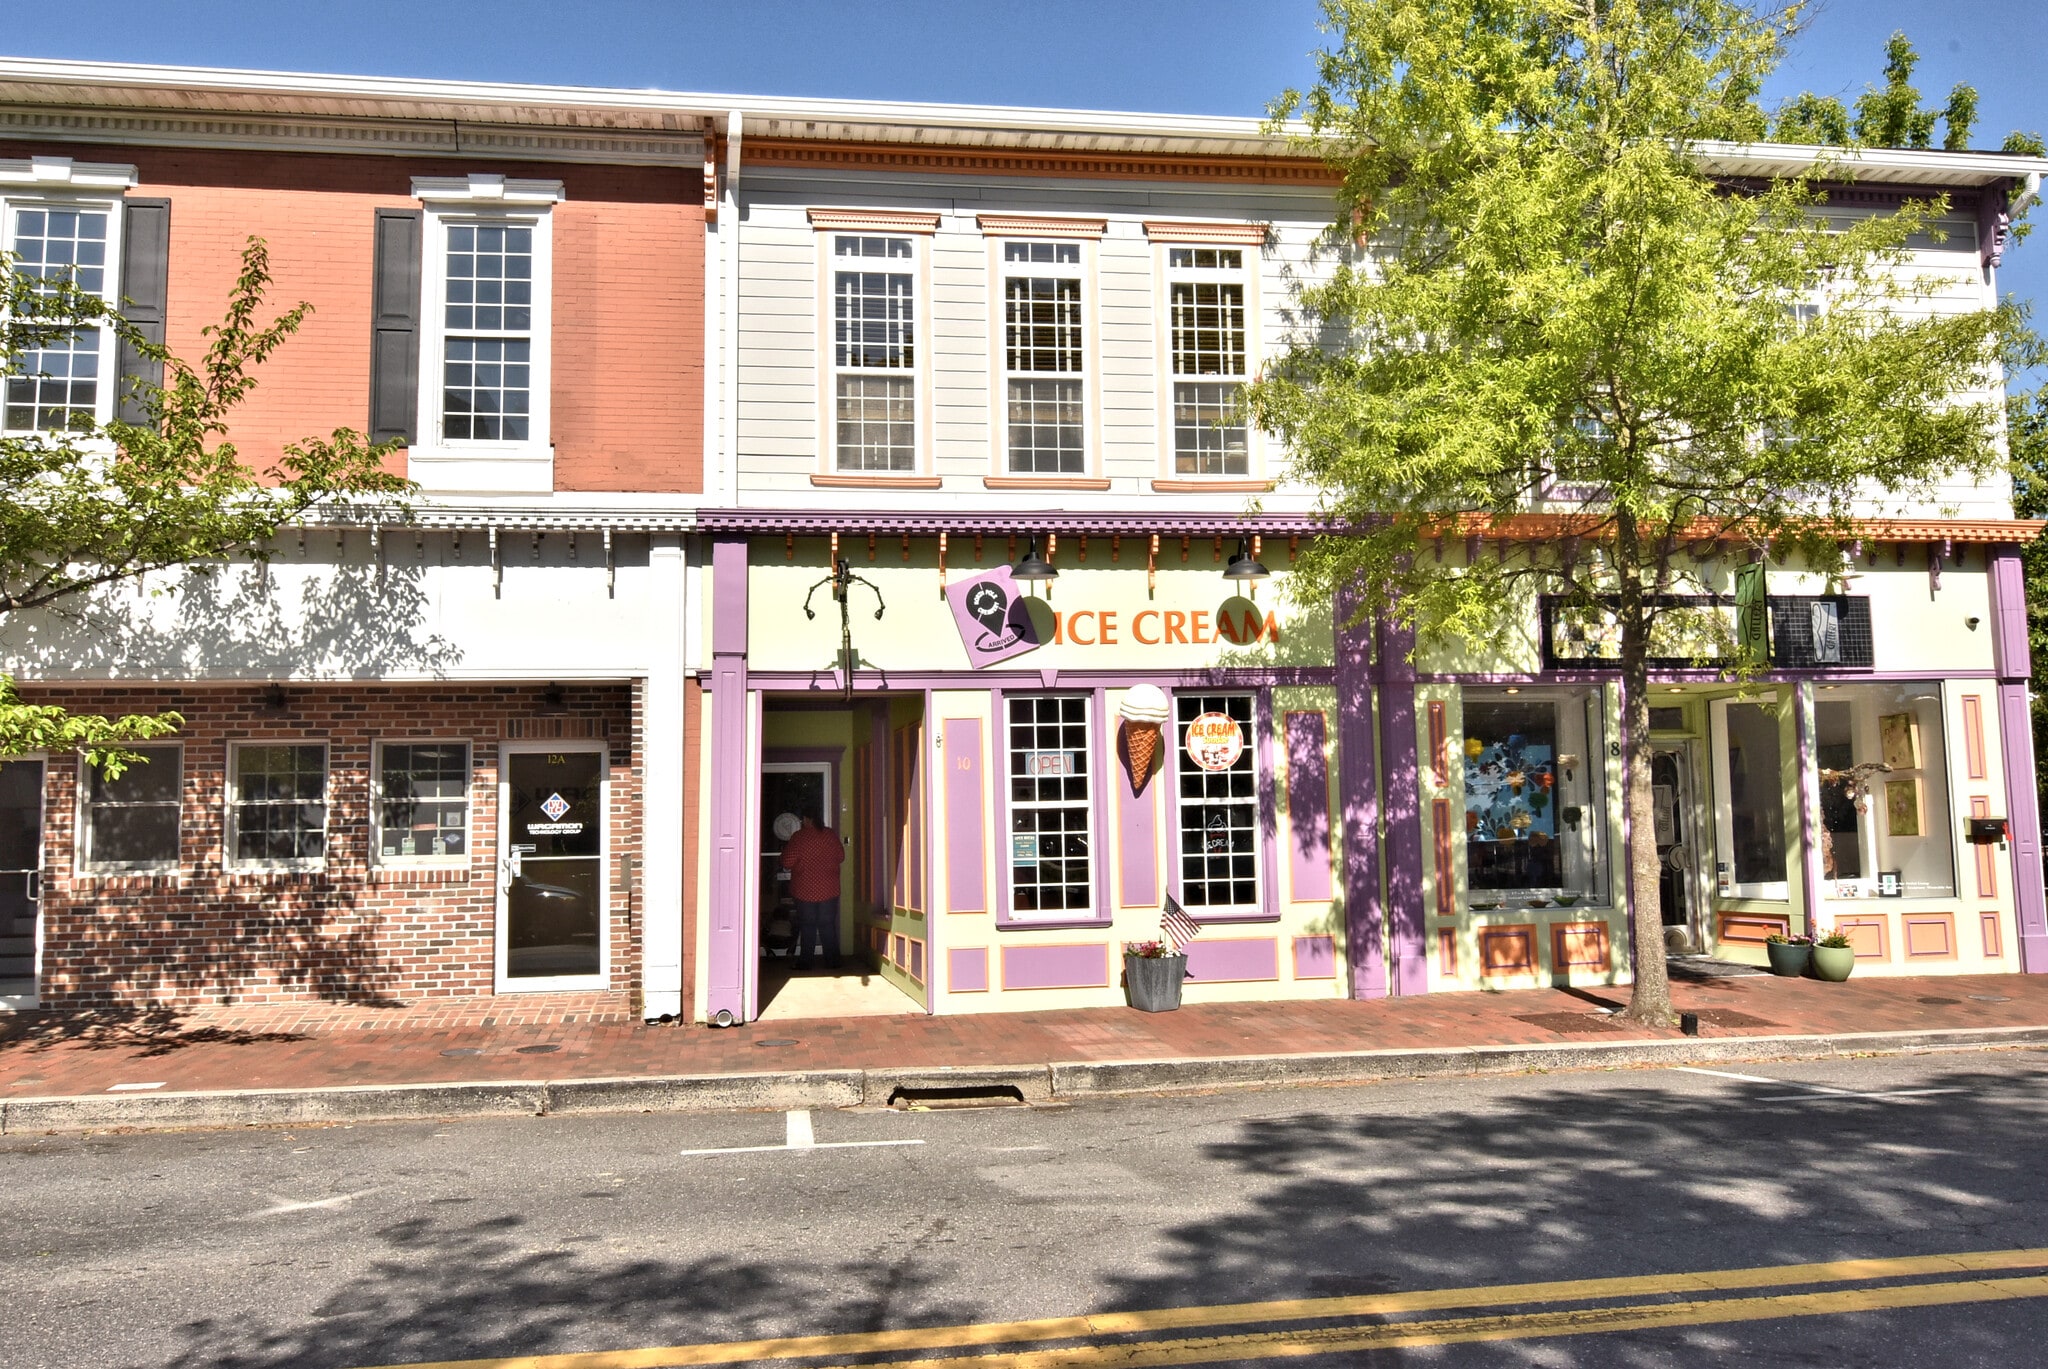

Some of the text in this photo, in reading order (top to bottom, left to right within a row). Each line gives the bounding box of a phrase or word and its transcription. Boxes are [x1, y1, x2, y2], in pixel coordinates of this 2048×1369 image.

[1053, 609, 1280, 645] ICE CREAM
[988, 634, 1015, 648] ARRIVED
[1191, 722, 1235, 737] ICE CREAM
[1611, 741, 1620, 756] 8
[547, 754, 566, 764] 12A
[956, 755, 971, 770] 10
[1029, 755, 1072, 775] OPEN
